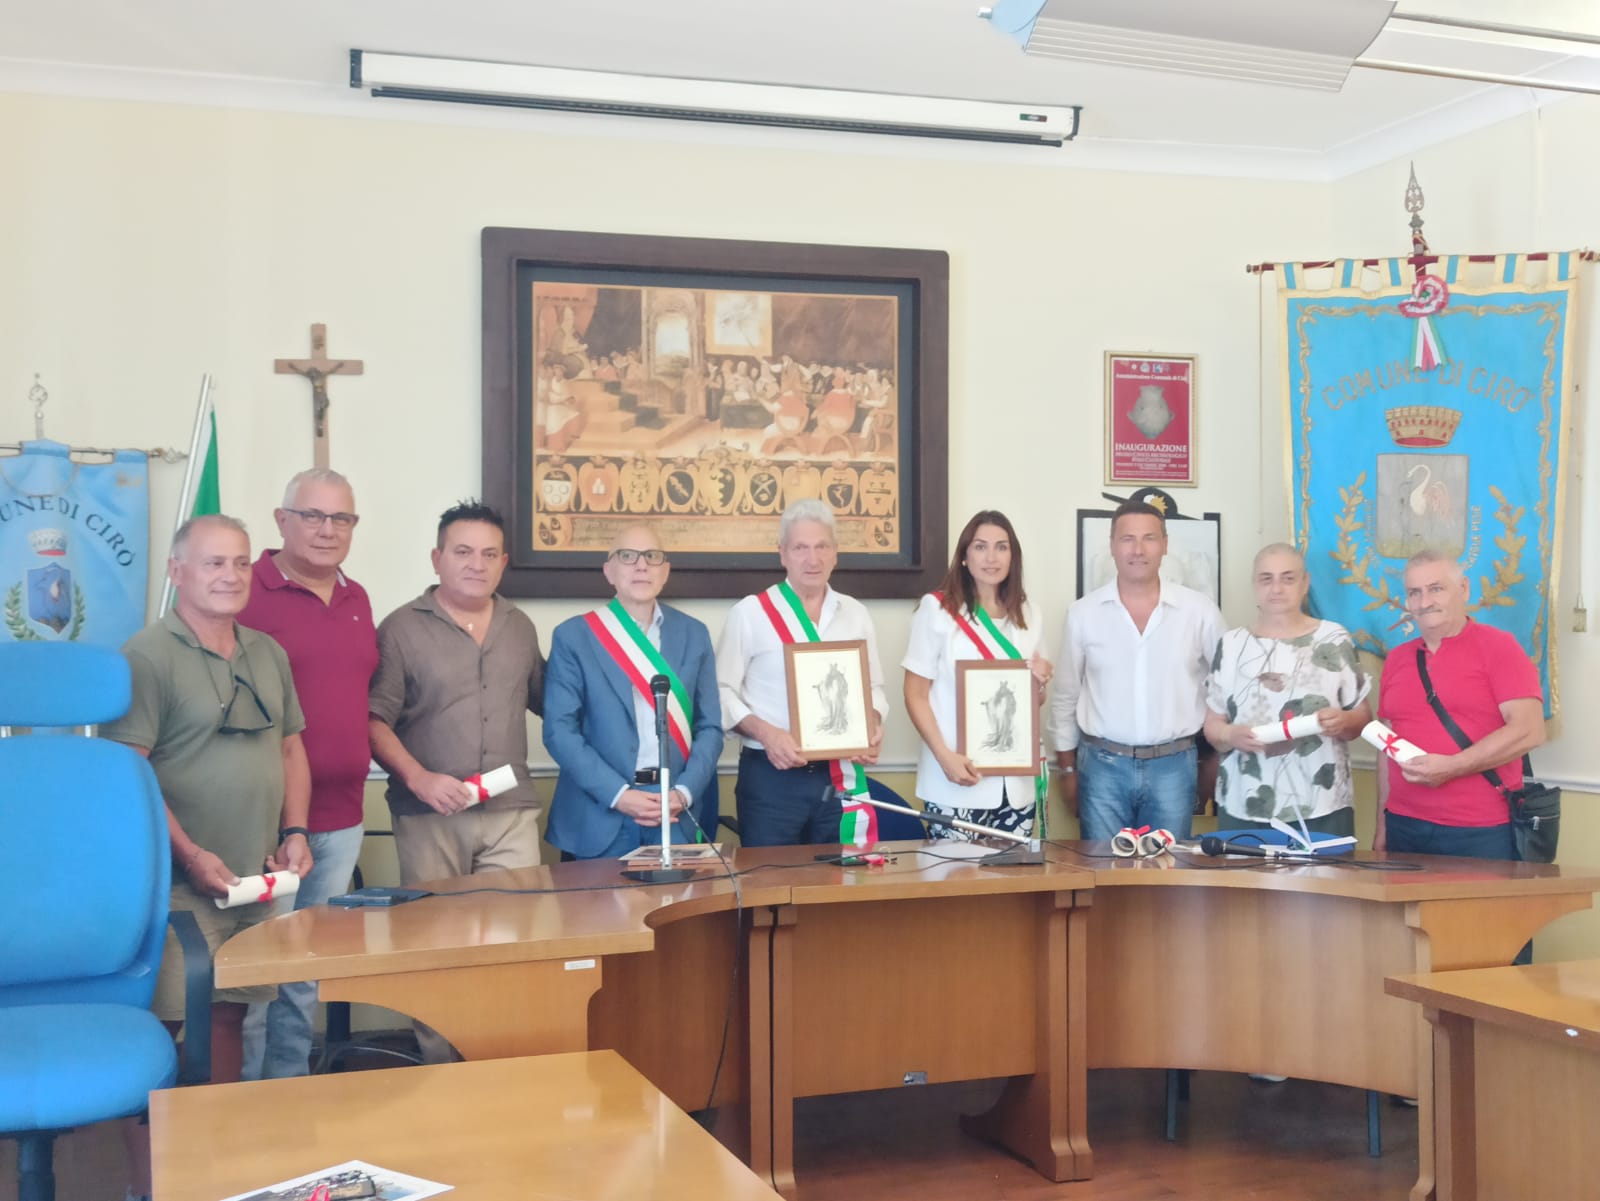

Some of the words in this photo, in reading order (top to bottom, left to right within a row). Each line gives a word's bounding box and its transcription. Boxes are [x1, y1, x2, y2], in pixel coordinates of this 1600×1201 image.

[1321, 356, 1430, 411] COMUNE
[1437, 356, 1465, 388] DI
[1115, 443, 1187, 453] INAUGURAZIONE
